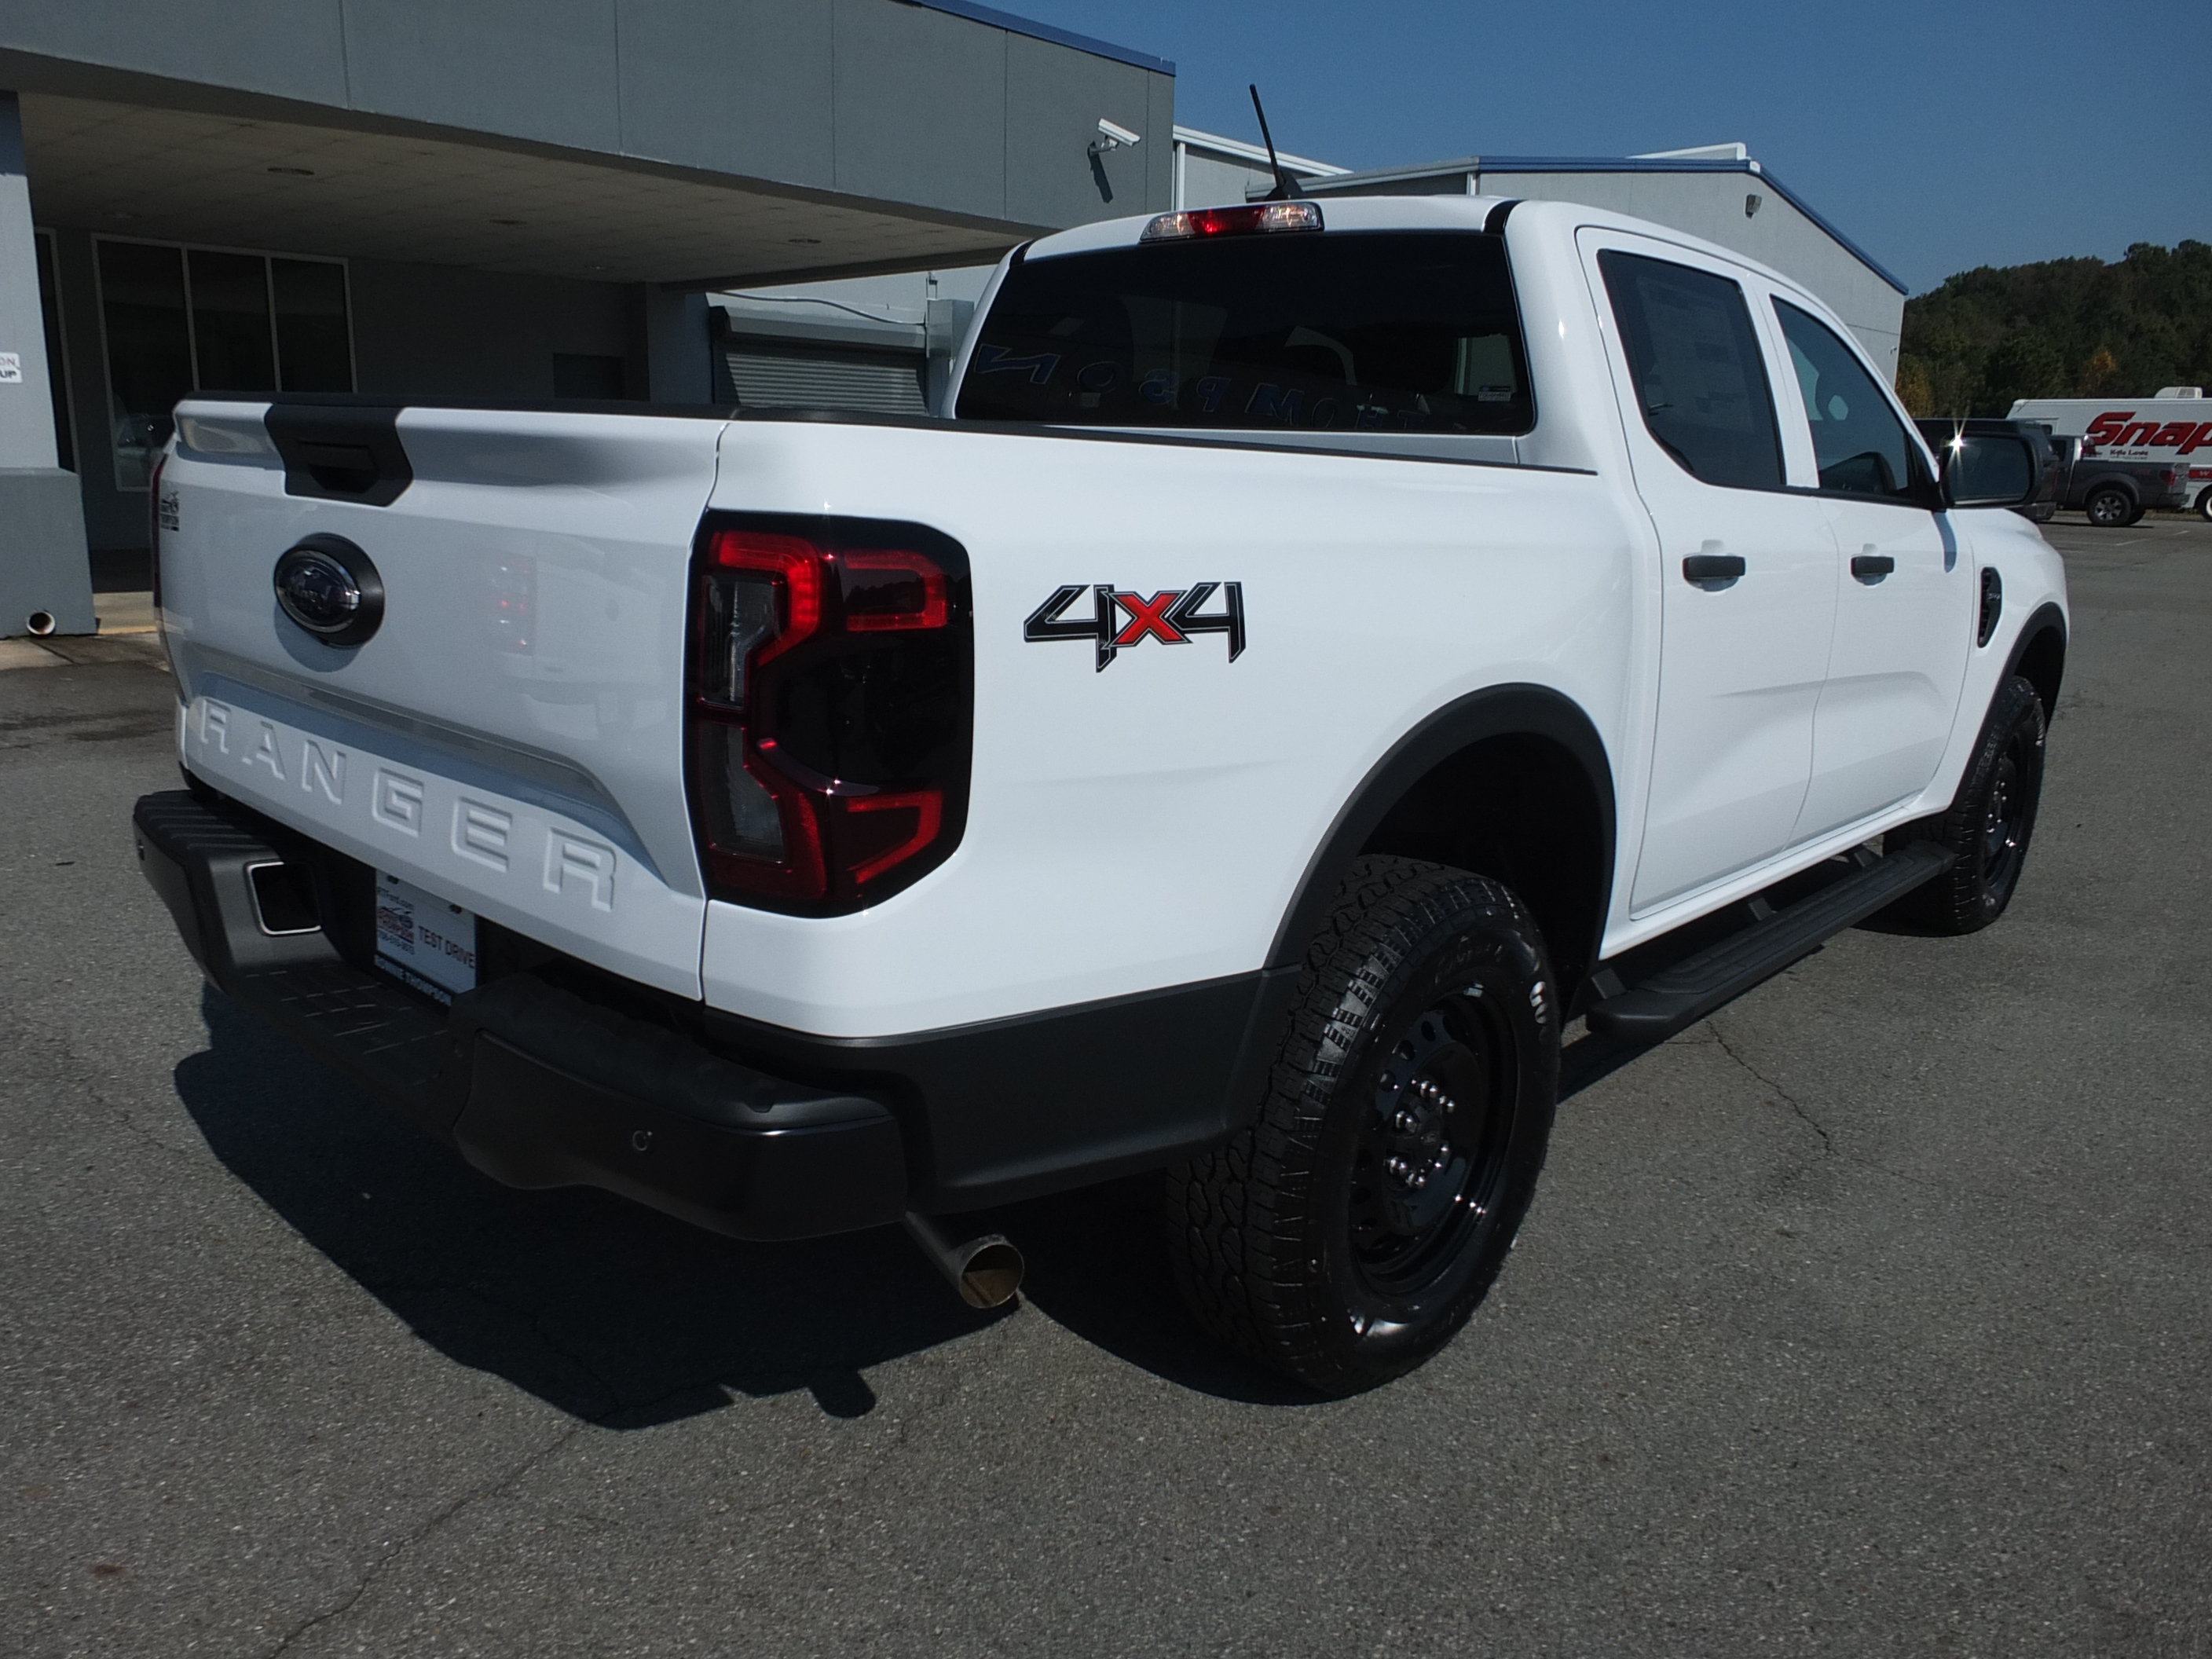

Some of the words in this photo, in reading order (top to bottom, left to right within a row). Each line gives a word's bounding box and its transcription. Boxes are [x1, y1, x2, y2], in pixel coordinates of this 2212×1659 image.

[200, 697, 616, 912] RANGER
[418, 925, 443, 951] TEST
[445, 939, 476, 969] DRIVE
